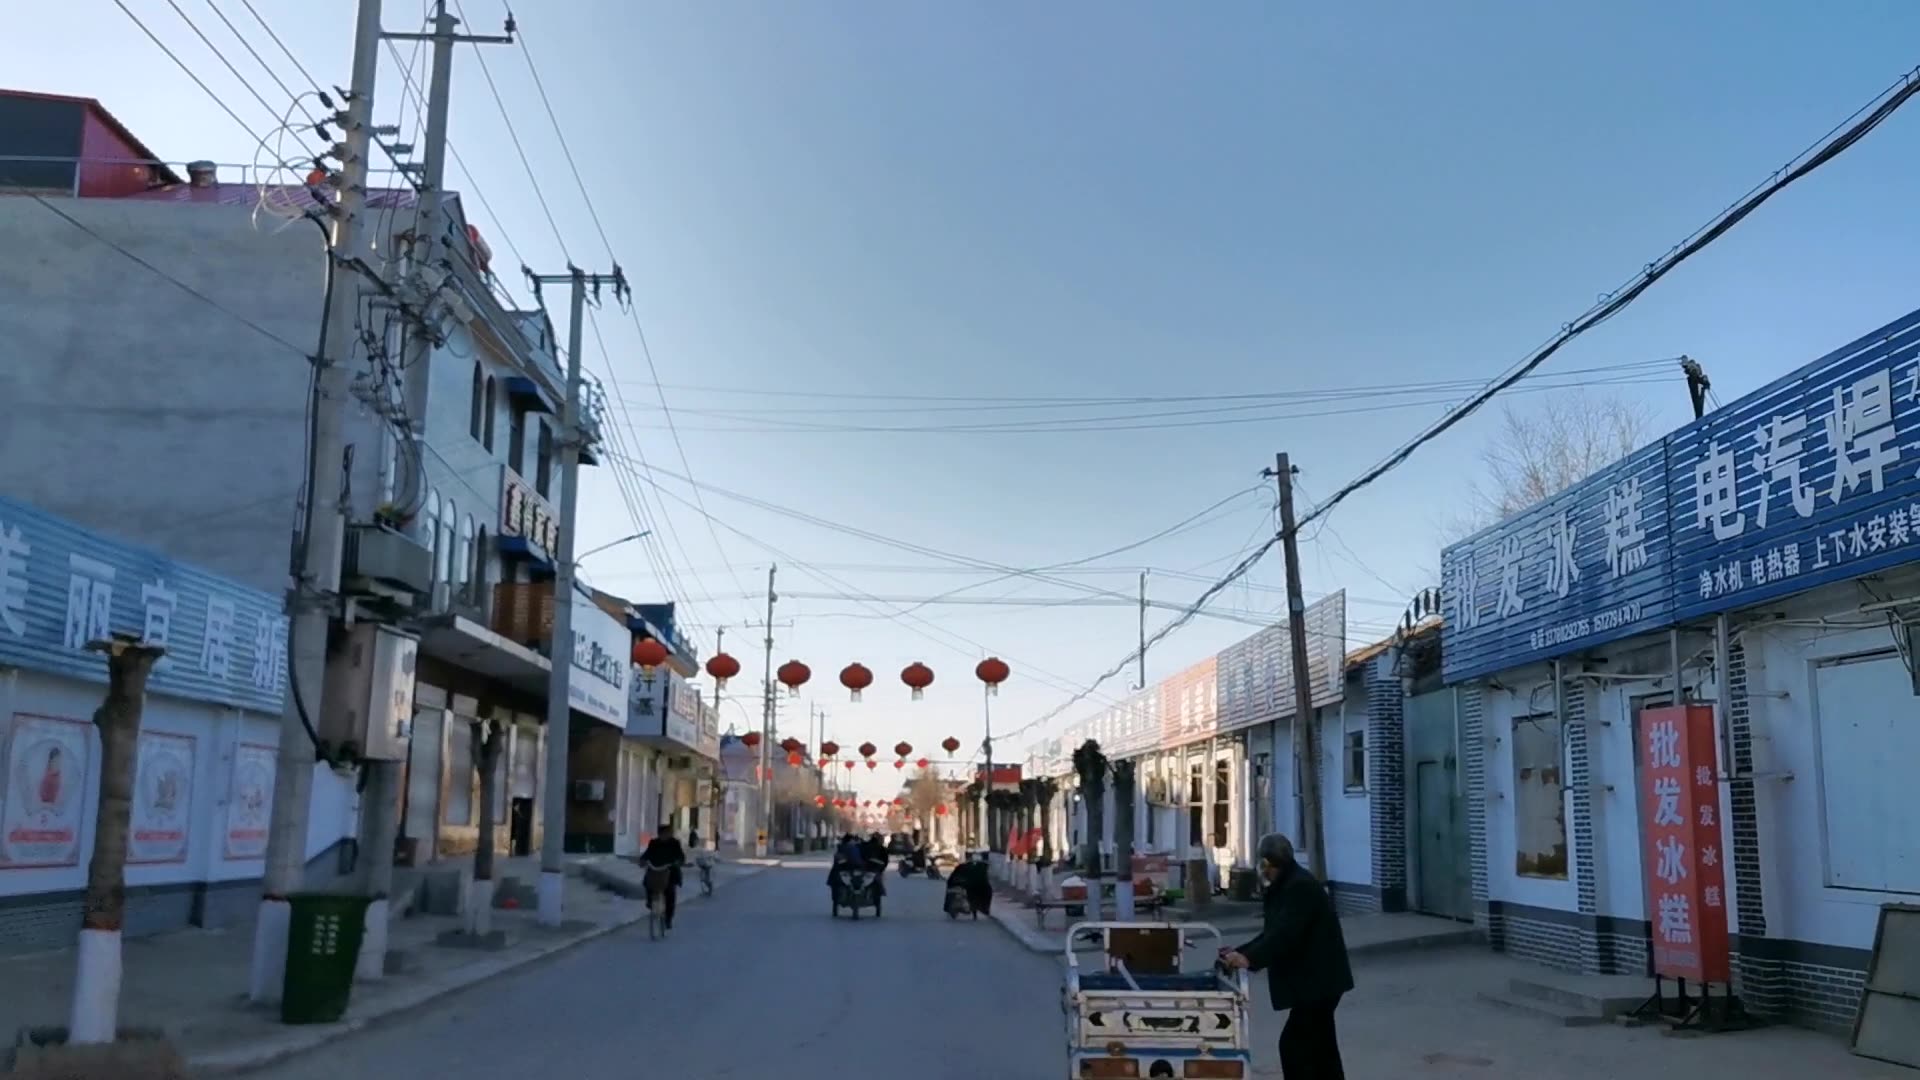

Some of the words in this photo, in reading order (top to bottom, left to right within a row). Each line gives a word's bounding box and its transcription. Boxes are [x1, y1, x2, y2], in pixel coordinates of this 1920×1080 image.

[1695, 354, 1920, 541] 电汽焊
[1454, 476, 1649, 633] 批发冰糕
[1699, 560, 1744, 599] 净水机
[1751, 543, 1800, 585] 电热器
[1649, 719, 1692, 944] 批发冰糕
[1696, 765, 1721, 907] 批发冰糕
